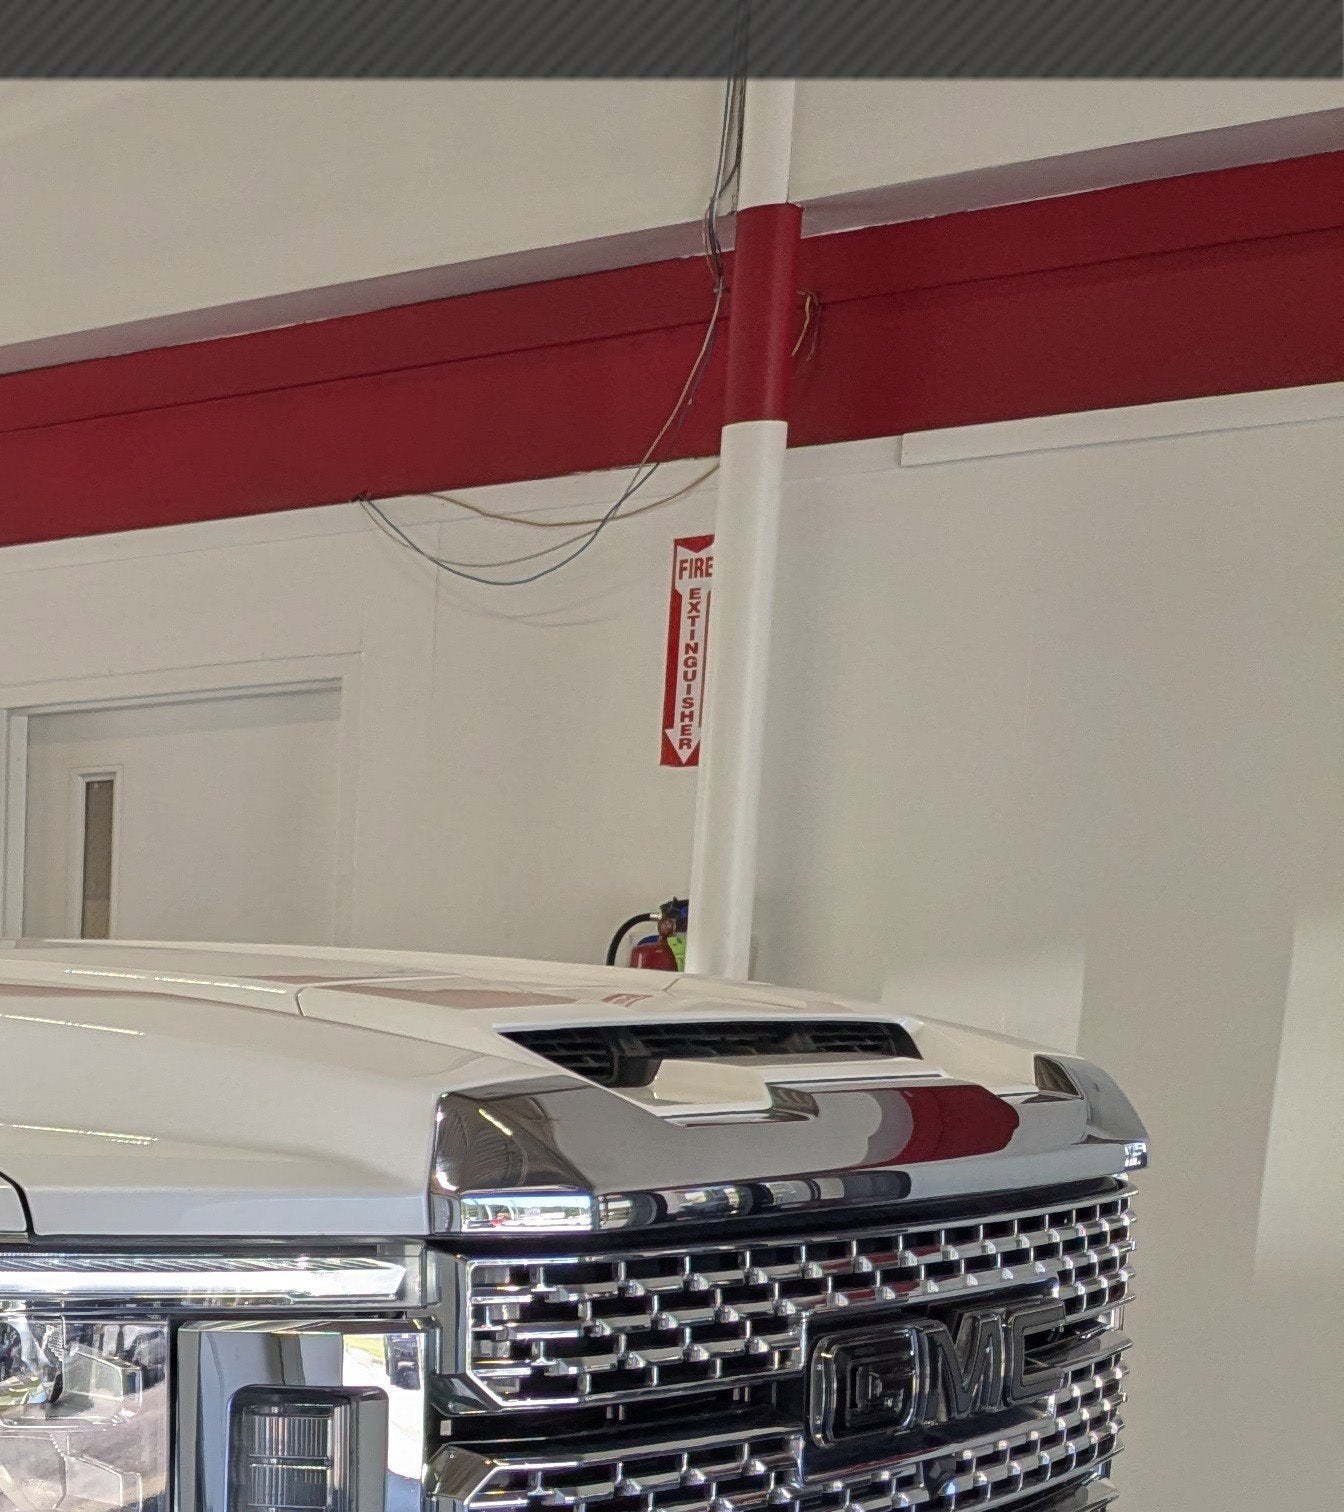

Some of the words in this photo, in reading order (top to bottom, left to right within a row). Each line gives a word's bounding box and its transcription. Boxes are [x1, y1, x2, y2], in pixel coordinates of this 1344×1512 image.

[678, 556, 714, 580] FIRE
[678, 587, 702, 750] EXTINGUISHER
[811, 1299, 1065, 1449] GMC
